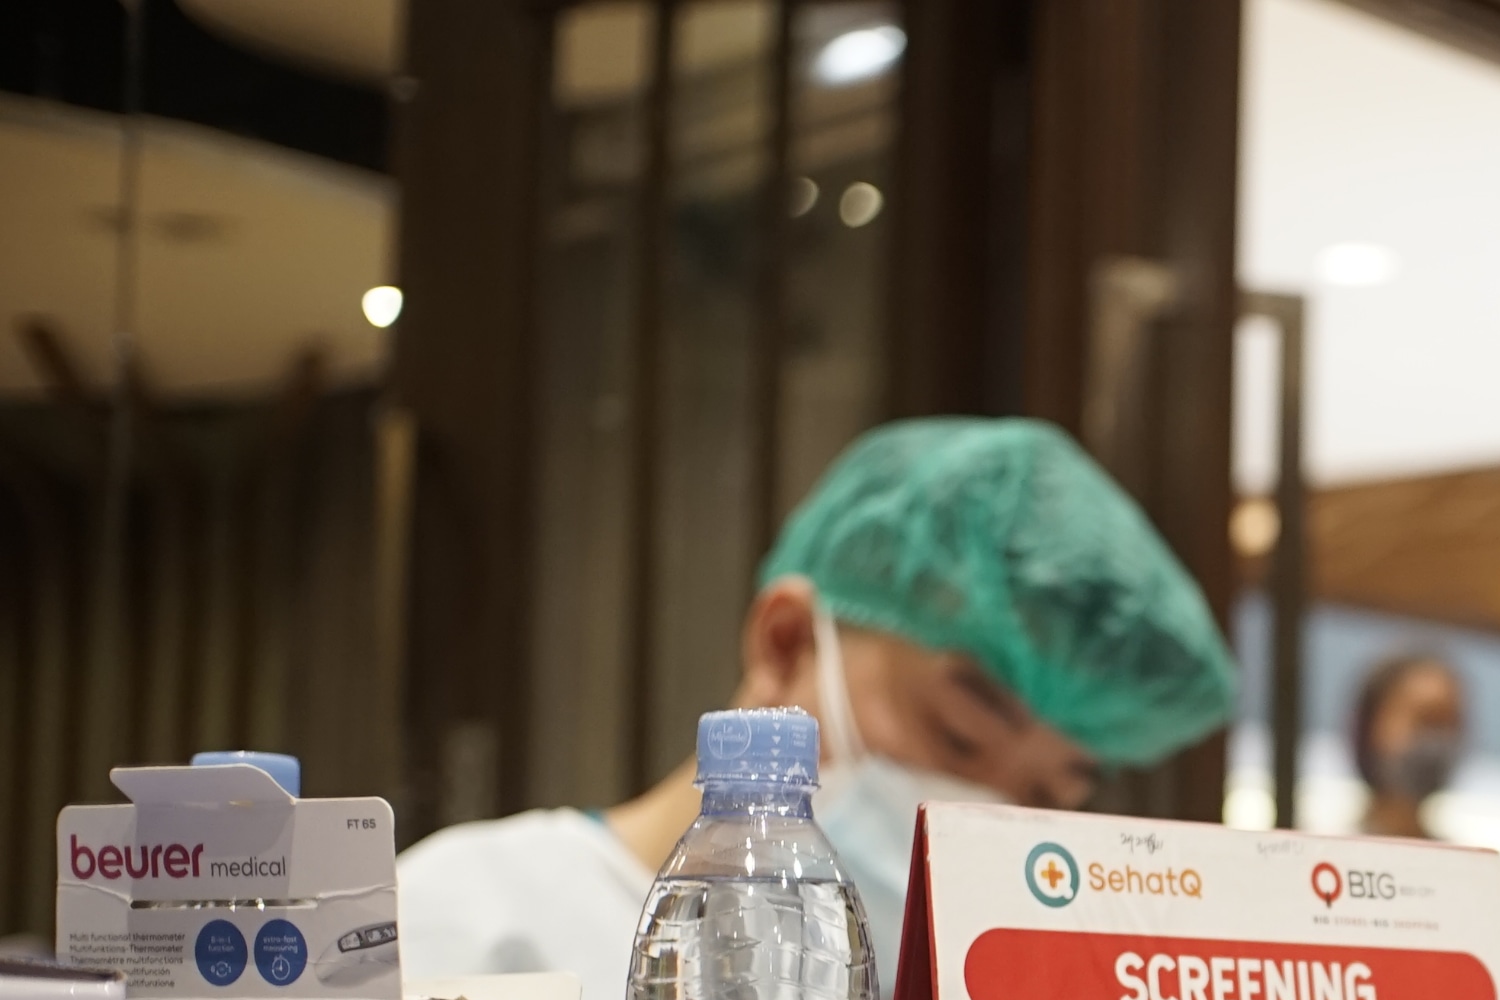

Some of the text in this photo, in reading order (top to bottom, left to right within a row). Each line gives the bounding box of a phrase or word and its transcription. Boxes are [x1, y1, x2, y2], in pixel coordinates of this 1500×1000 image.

[347, 818, 376, 830] FT 65
[69, 833, 286, 880] beurer medical
[1088, 862, 1203, 899] SehatQ
[1347, 870, 1396, 900] BIG
[69, 933, 186, 942] Multi functional thermometer
